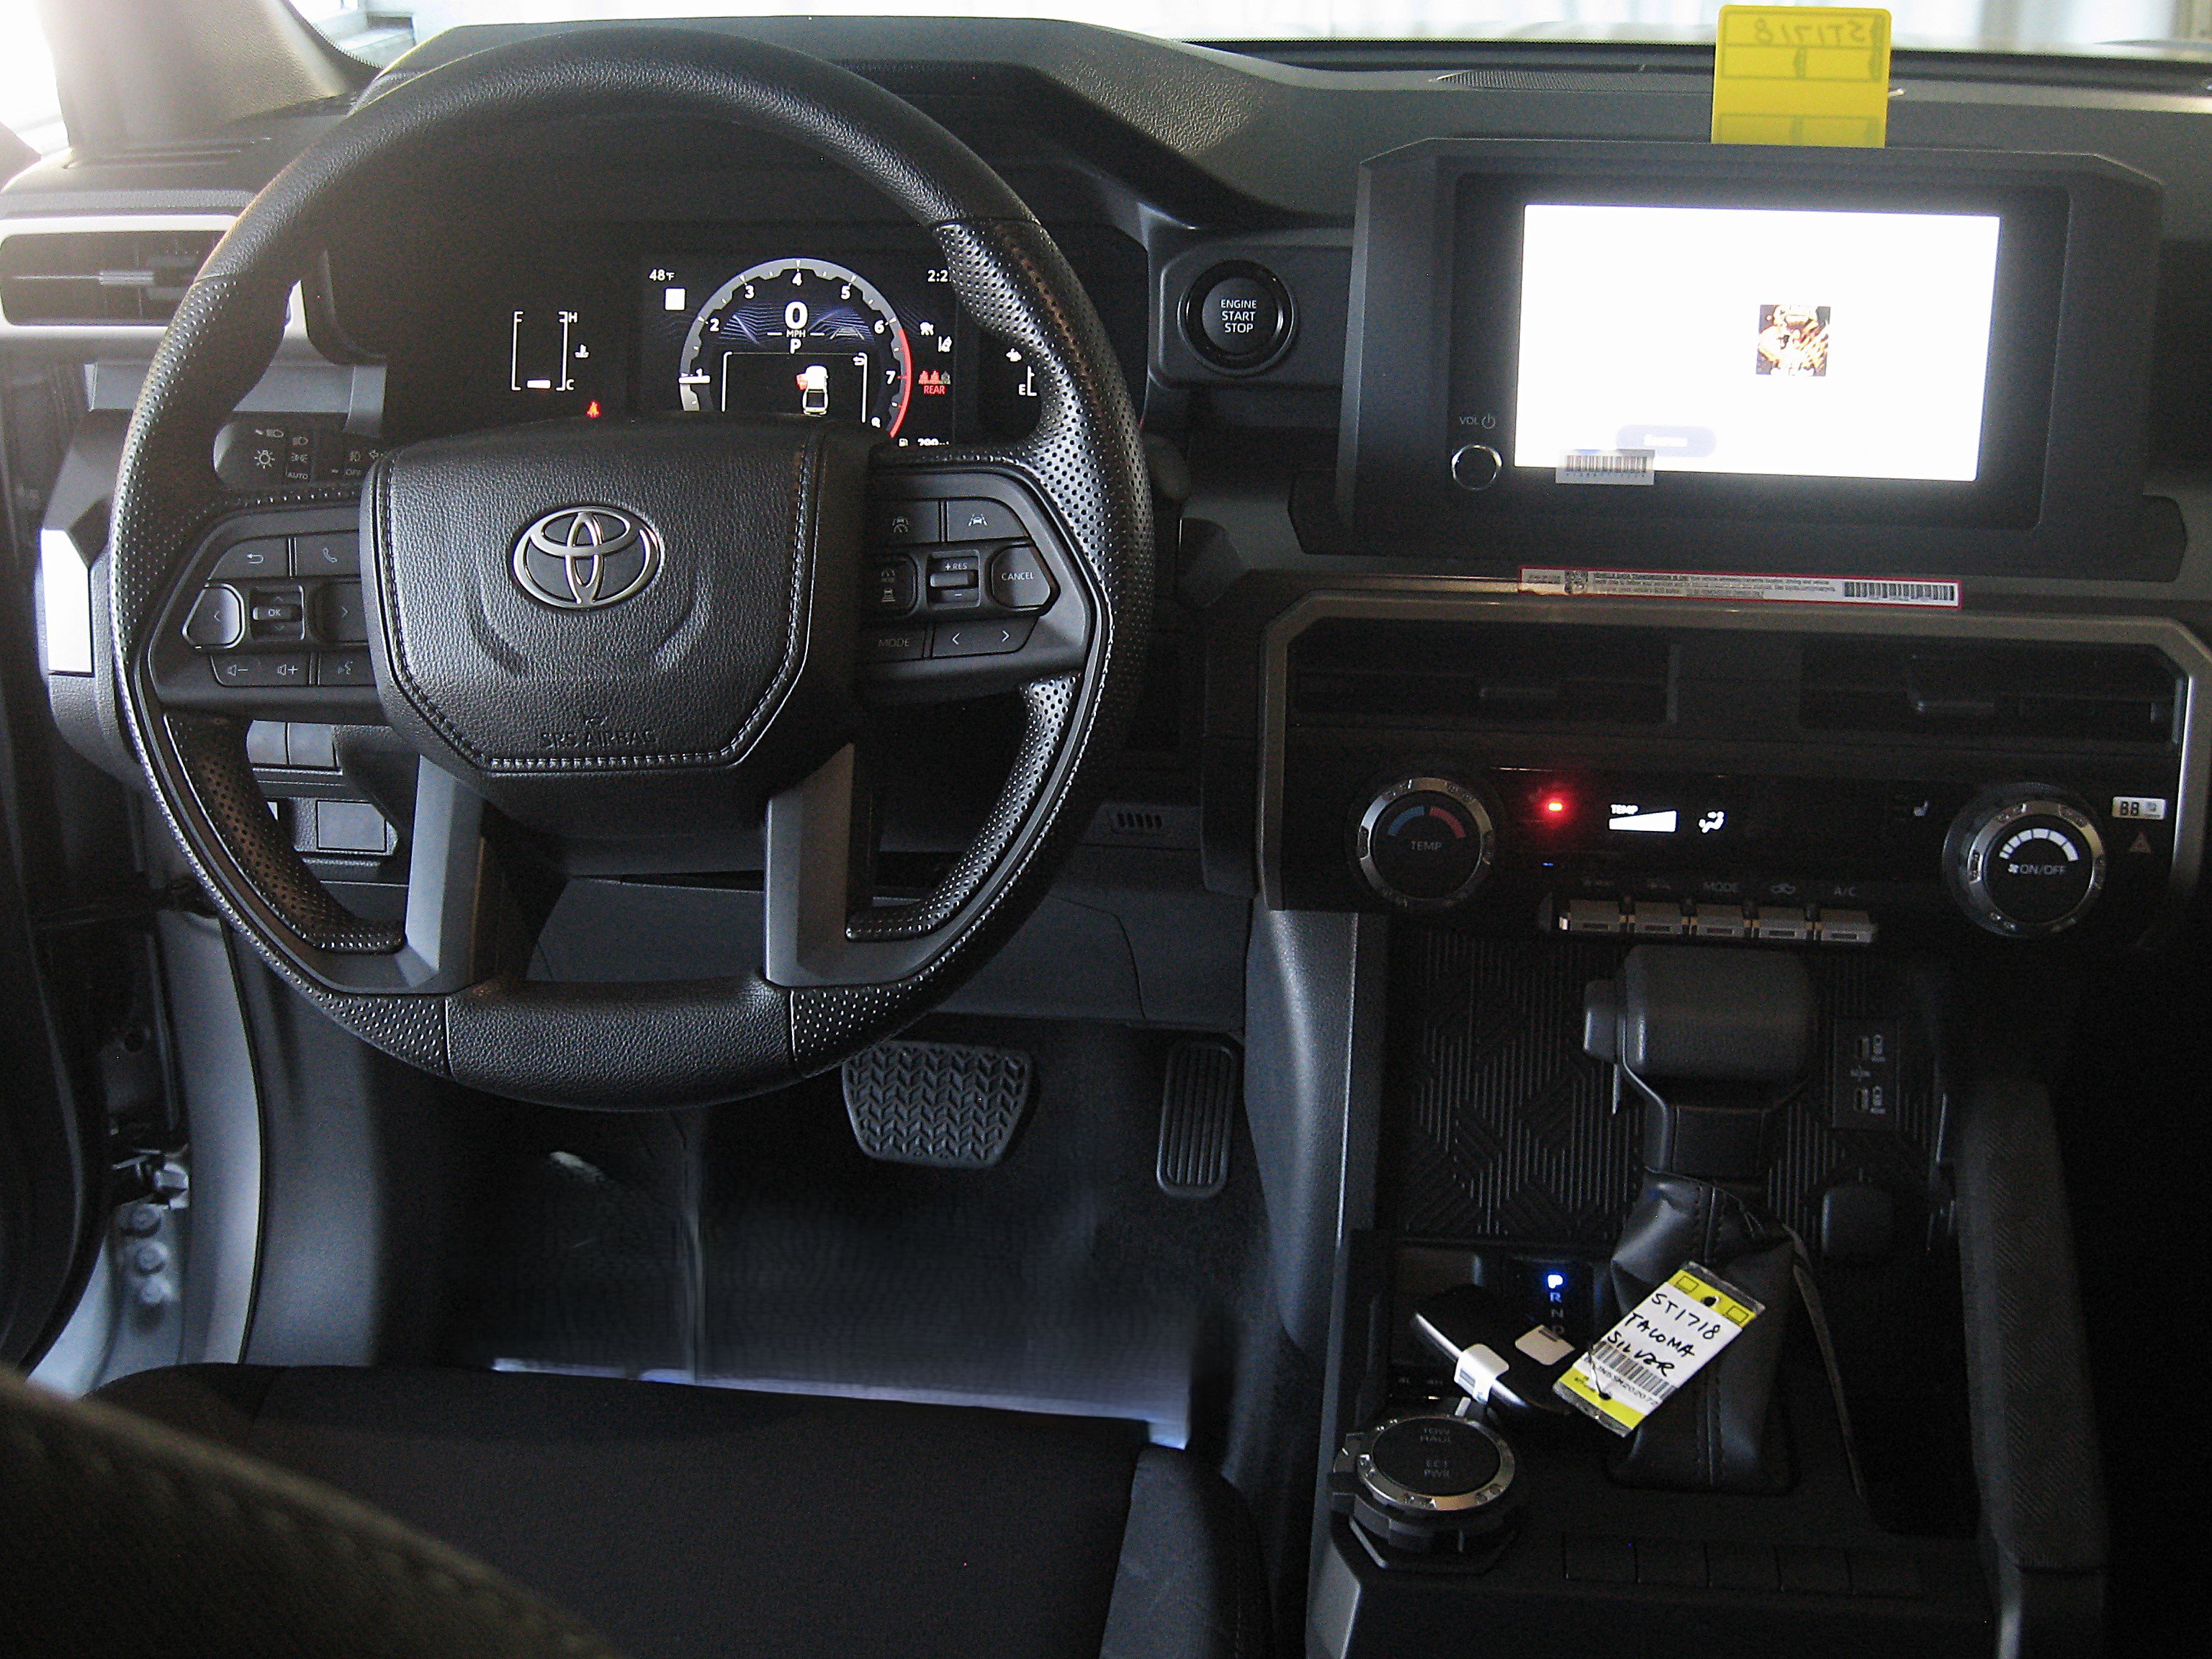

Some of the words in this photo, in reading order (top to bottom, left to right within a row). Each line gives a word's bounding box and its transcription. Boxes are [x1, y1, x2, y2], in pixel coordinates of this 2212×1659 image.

[792, 272, 802, 286] 4
[927, 269, 949, 282] 2:2
[745, 285, 755, 299] 3
[841, 286, 851, 300] 5
[1220, 300, 1257, 309] ENGINE
[785, 302, 808, 329] 0
[1222, 310, 1256, 321] START
[710, 318, 719, 332] 2
[874, 320, 884, 334] 6
[1225, 323, 1254, 333] STOP
[790, 338, 801, 354] P
[886, 371, 896, 385] 7
[924, 385, 945, 395] REAR
[1460, 416, 1478, 426] VOL
[1002, 572, 1033, 581] CANCEL
[878, 639, 910, 647] MODE
[1411, 840, 1442, 851] TEMP
[2020, 866, 2067, 876] ON/OFF
[1703, 882, 1739, 893] MODE
[1833, 886, 1856, 896] A/C
[1547, 1274, 1563, 1289] P
[1550, 1292, 1562, 1303] R
[1551, 1308, 1564, 1318] N
[1651, 1292, 1722, 1340] ST1718
